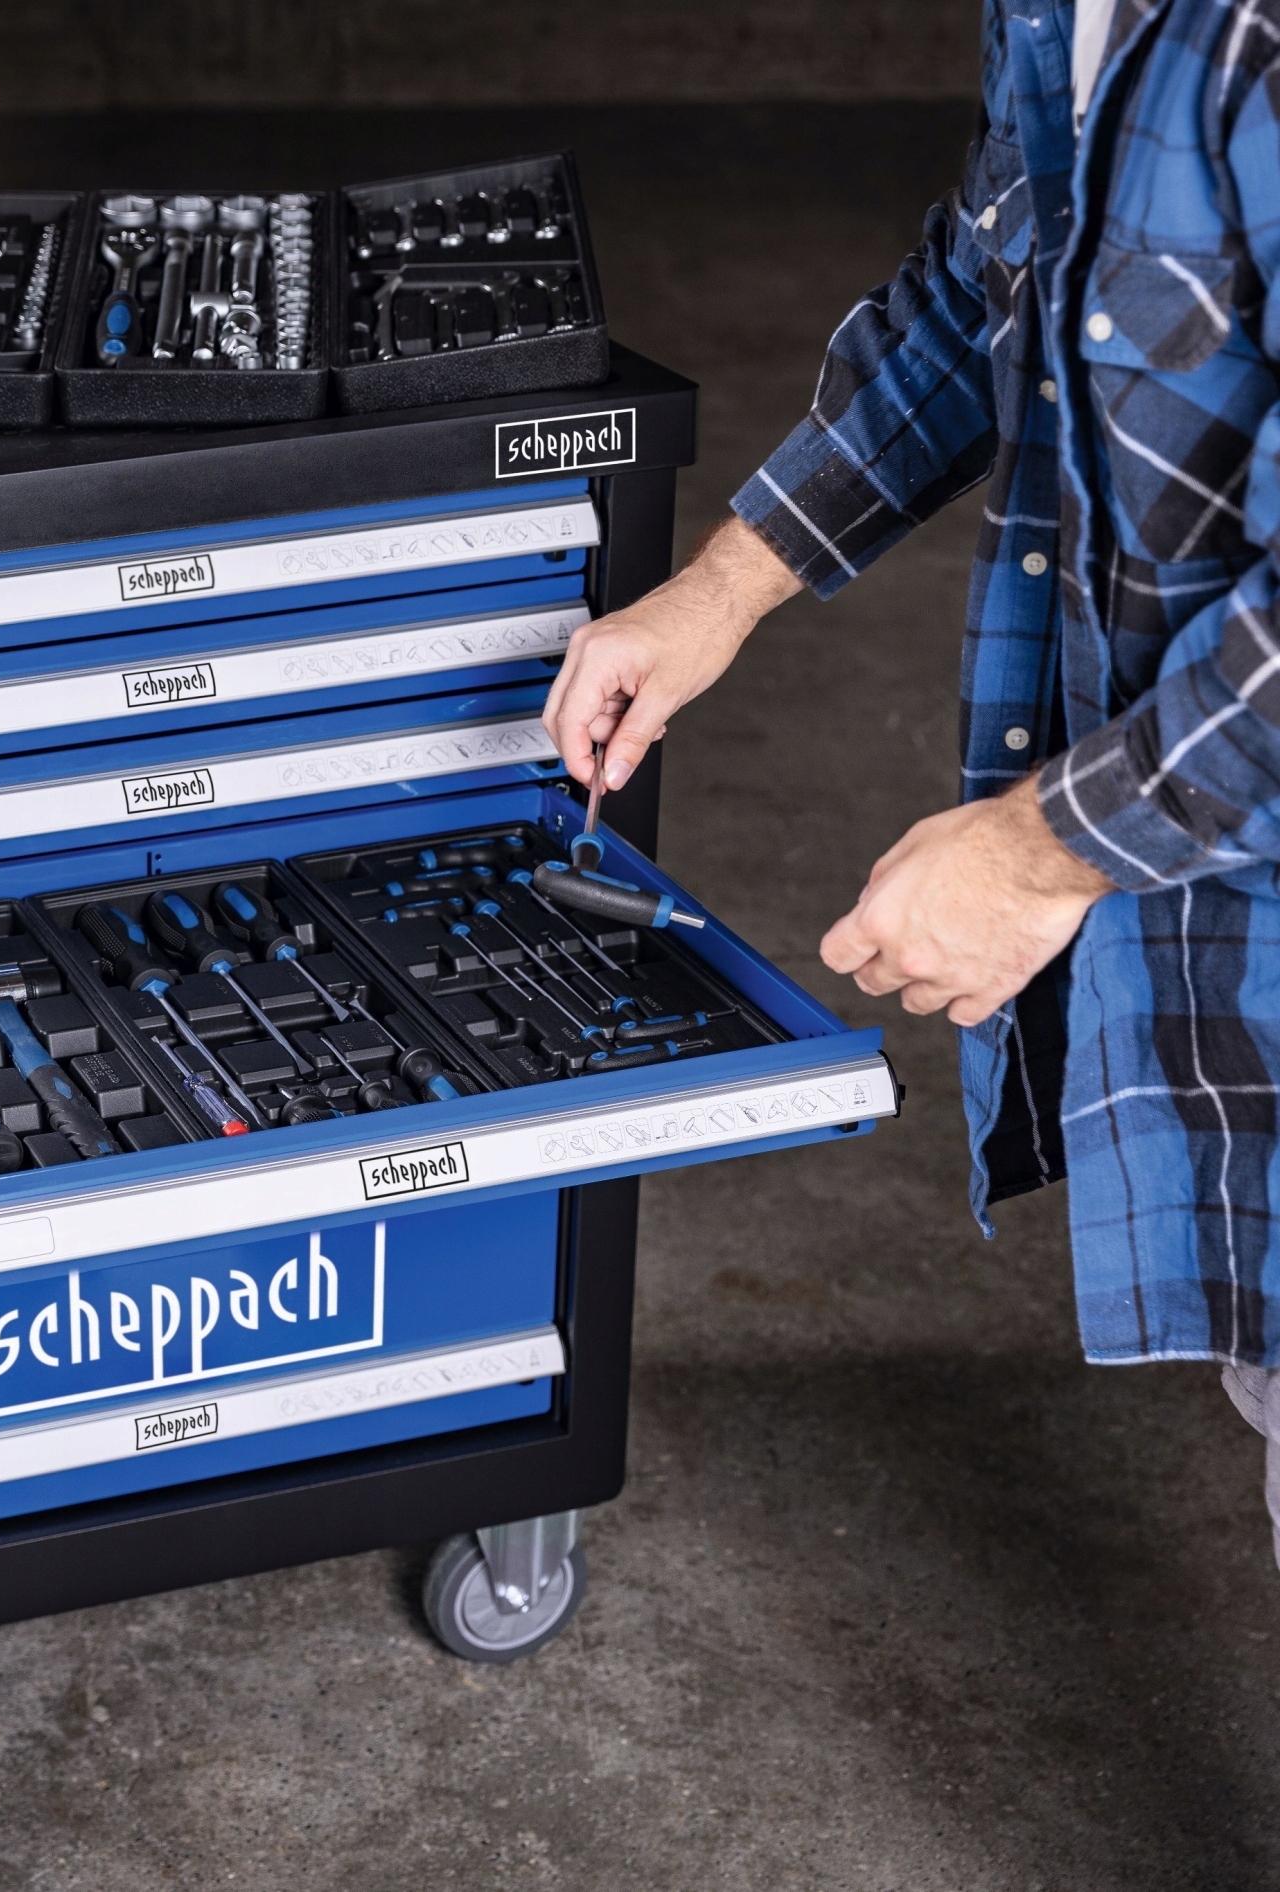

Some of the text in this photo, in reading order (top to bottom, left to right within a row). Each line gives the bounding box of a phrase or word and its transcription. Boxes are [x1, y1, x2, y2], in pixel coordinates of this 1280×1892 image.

[508, 411, 622, 468] scheppach
[128, 556, 206, 595] scheppach
[133, 664, 207, 701] scheppach
[132, 770, 206, 808] scheppach
[371, 1144, 458, 1190] scheppach
[144, 1405, 211, 1441] scheppach
